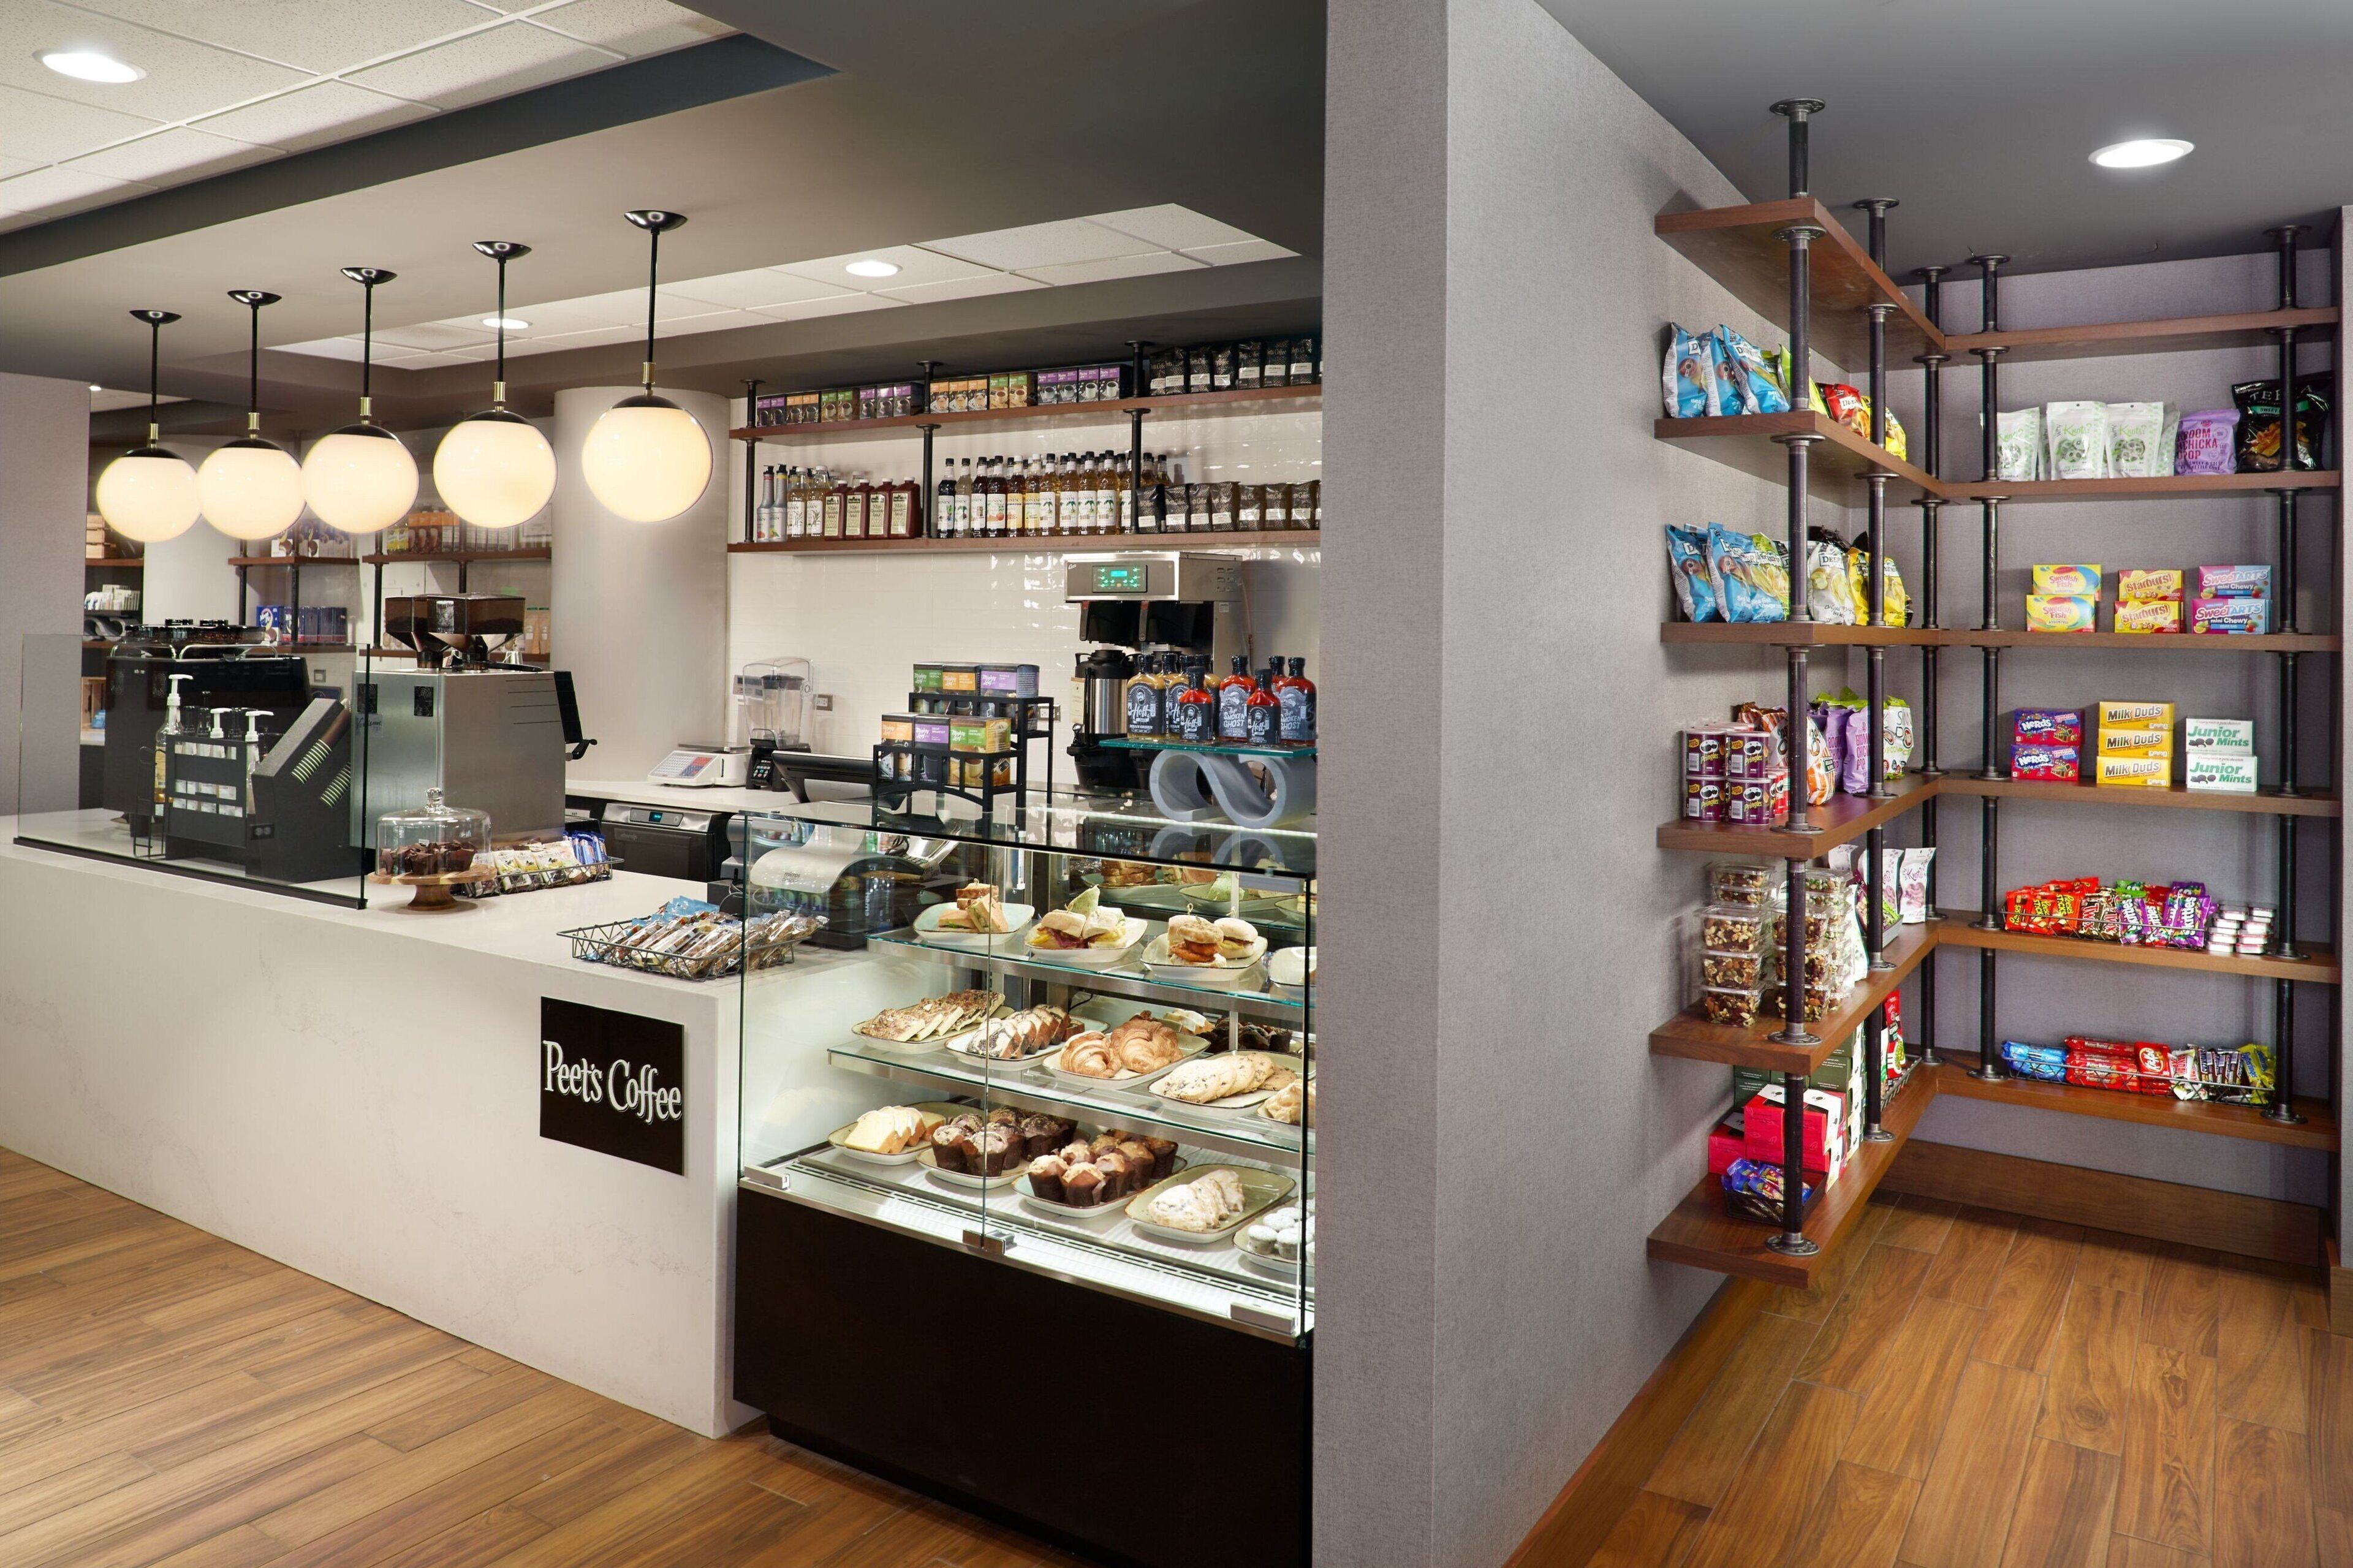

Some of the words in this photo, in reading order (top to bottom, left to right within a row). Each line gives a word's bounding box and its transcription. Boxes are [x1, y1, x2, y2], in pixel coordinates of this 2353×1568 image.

[2049, 575, 2079, 584] Swedish
[2043, 605, 2072, 615] Swedish
[2107, 709, 2132, 721] Milk
[2135, 705, 2162, 717] Duds
[1223, 719, 1245, 728] GHOST
[2188, 726, 2240, 738] Junior
[2107, 737, 2131, 749] Milk
[2134, 733, 2162, 744] Duds
[2216, 738, 2249, 746] Mints
[1700, 752, 1719, 764] Pringles
[1745, 754, 1763, 765] Pringles
[2105, 764, 2130, 777] Milk
[2132, 761, 2161, 773] Duds
[2189, 763, 2243, 774] Junior
[2219, 774, 2252, 784] Mints
[1700, 798, 1719, 810] Pringles
[1744, 800, 1762, 812] Pringles
[2180, 896, 2197, 936] Skittles
[543, 1040, 603, 1103] Peet's
[607, 1059, 682, 1124] Coffee
